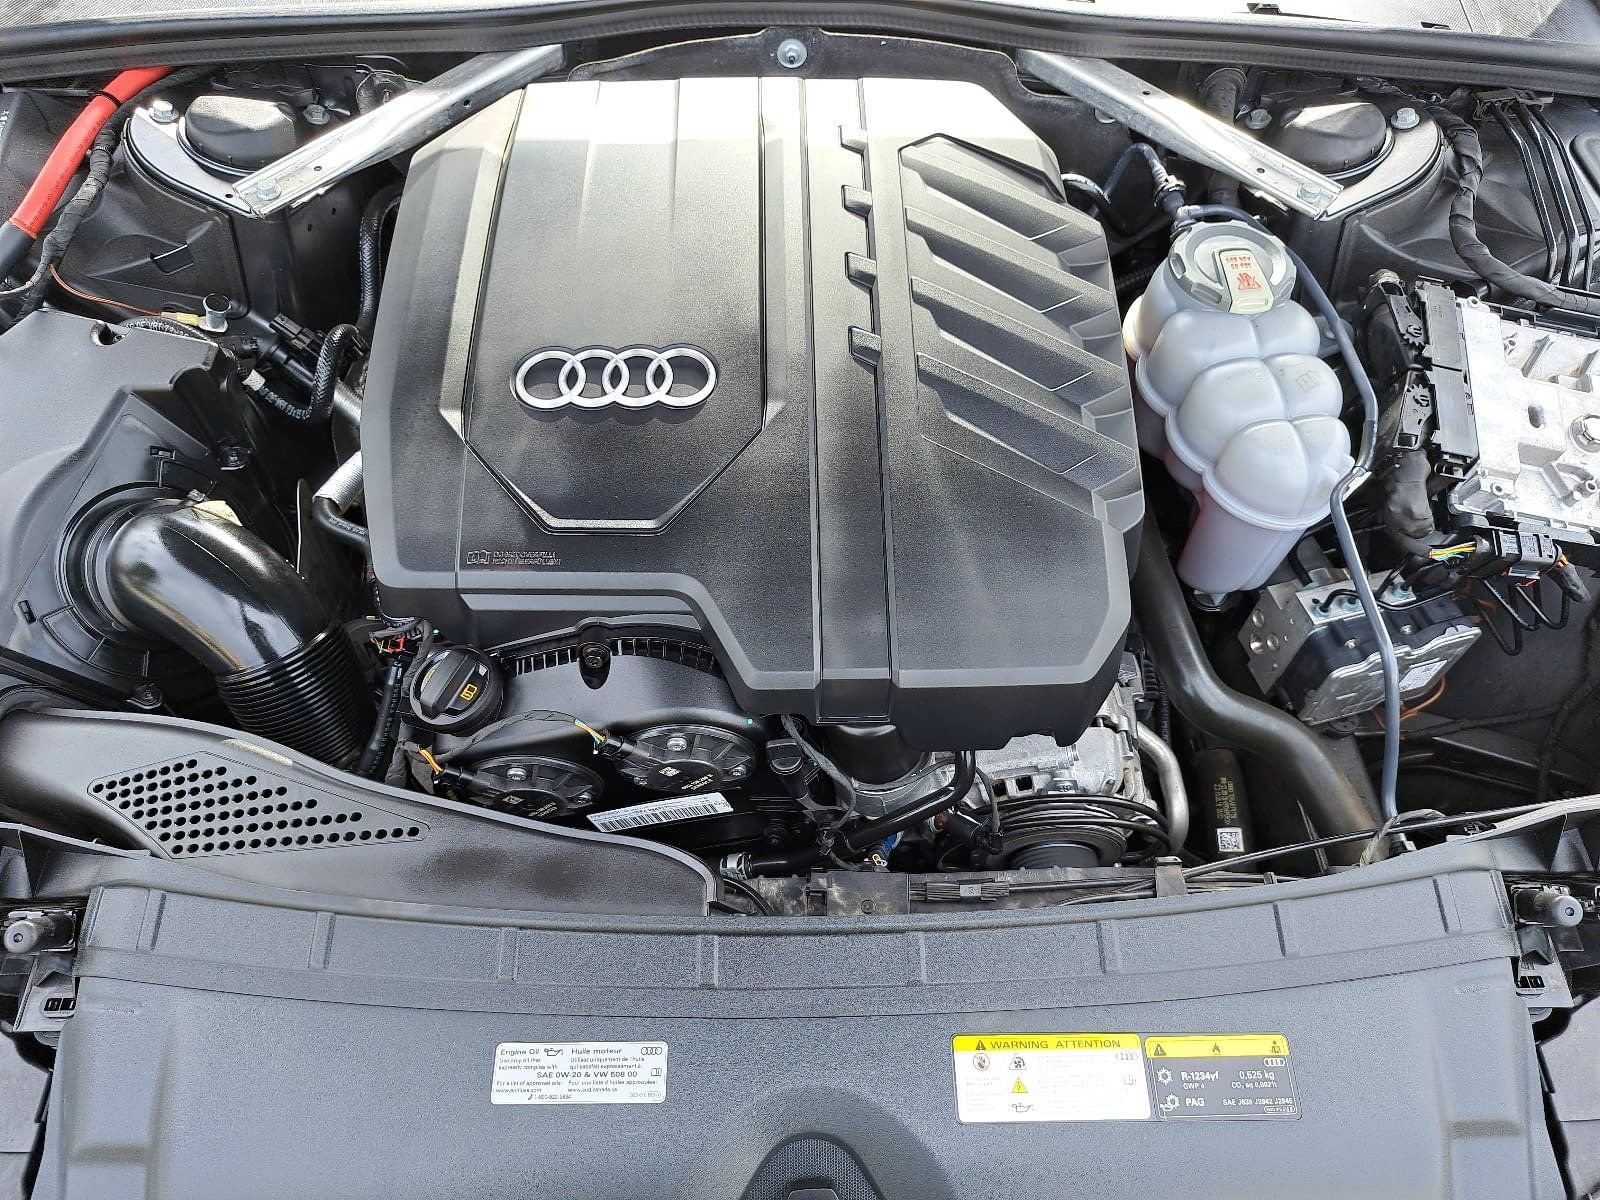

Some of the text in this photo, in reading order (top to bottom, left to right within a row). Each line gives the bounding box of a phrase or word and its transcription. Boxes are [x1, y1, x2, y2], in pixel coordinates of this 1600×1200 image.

[990, 1040, 1120, 1048] WARNING ATTENTION
[1180, 1071, 1219, 1081] R-1234yf
[1264, 1070, 1274, 1080] kg
[1186, 1098, 1205, 1106] PAG
